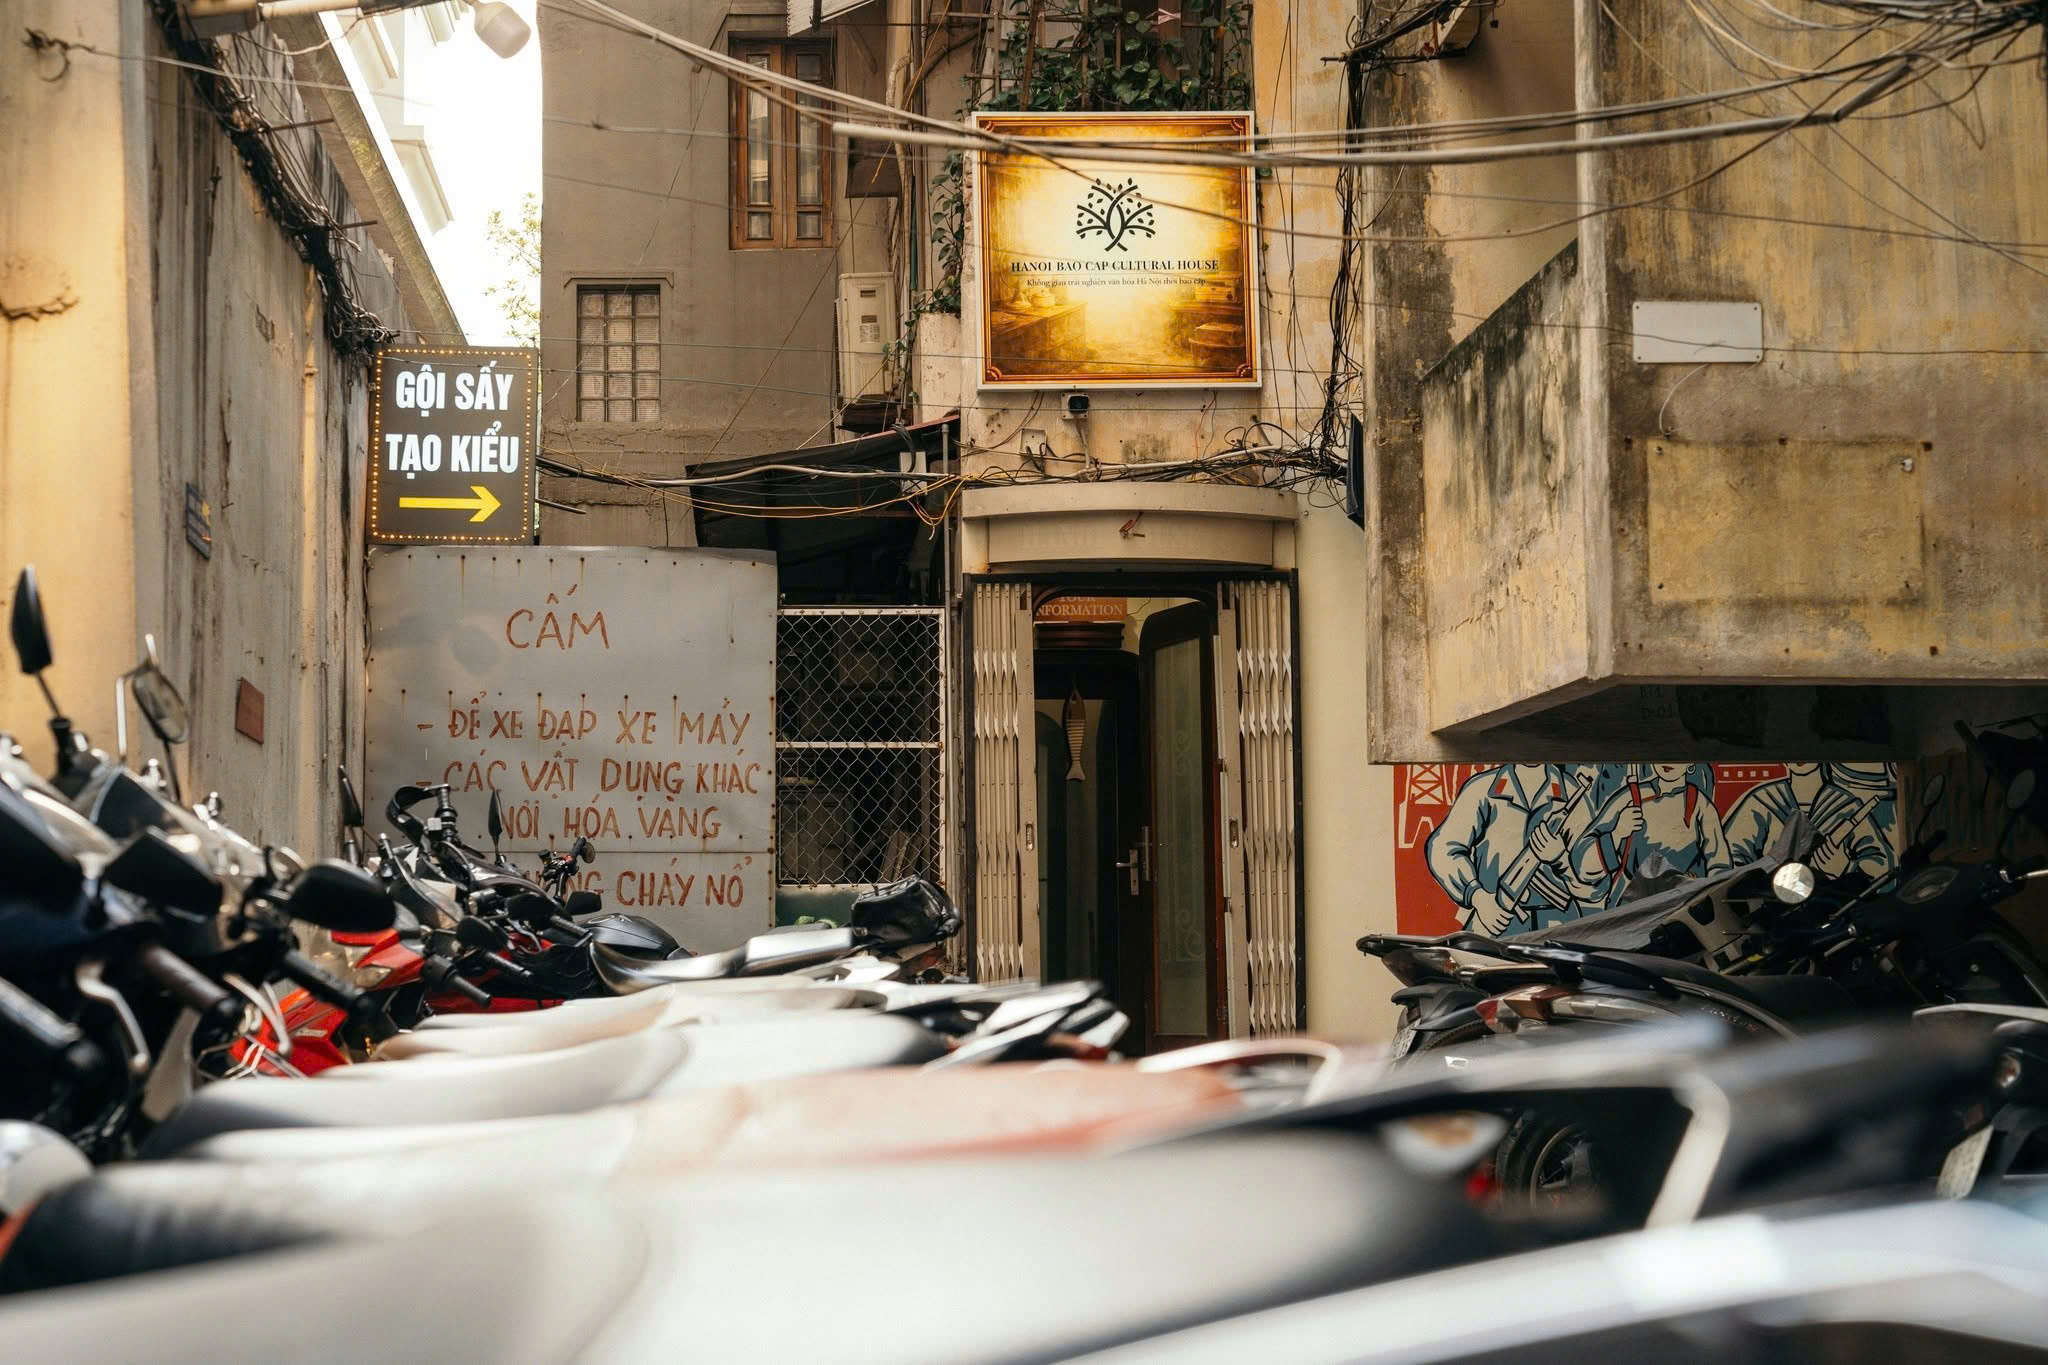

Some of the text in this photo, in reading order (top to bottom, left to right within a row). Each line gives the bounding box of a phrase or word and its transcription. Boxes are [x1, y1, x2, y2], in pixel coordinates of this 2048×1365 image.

[1011, 259, 1219, 272] HANOI BAO CAP CULTURAL HOUSE
[396, 360, 514, 417] GỘI SẤY
[385, 420, 520, 479] TẠO KIỂU
[506, 584, 610, 650] CẤM
[1037, 604, 1123, 616] NFORMATION
[448, 691, 487, 740] ĐỂ
[489, 710, 523, 740] XE
[538, 709, 598, 747] ĐẠP
[615, 711, 657, 745] XE
[679, 697, 750, 745] MÁY
[444, 748, 507, 793] CÁC
[521, 750, 578, 799] VẬT
[696, 748, 761, 795] KHÁC
[563, 792, 621, 840] HÓA
[638, 795, 722, 839] VÀNG
[616, 857, 696, 907] CHÁY
[705, 855, 753, 908] NỔ
